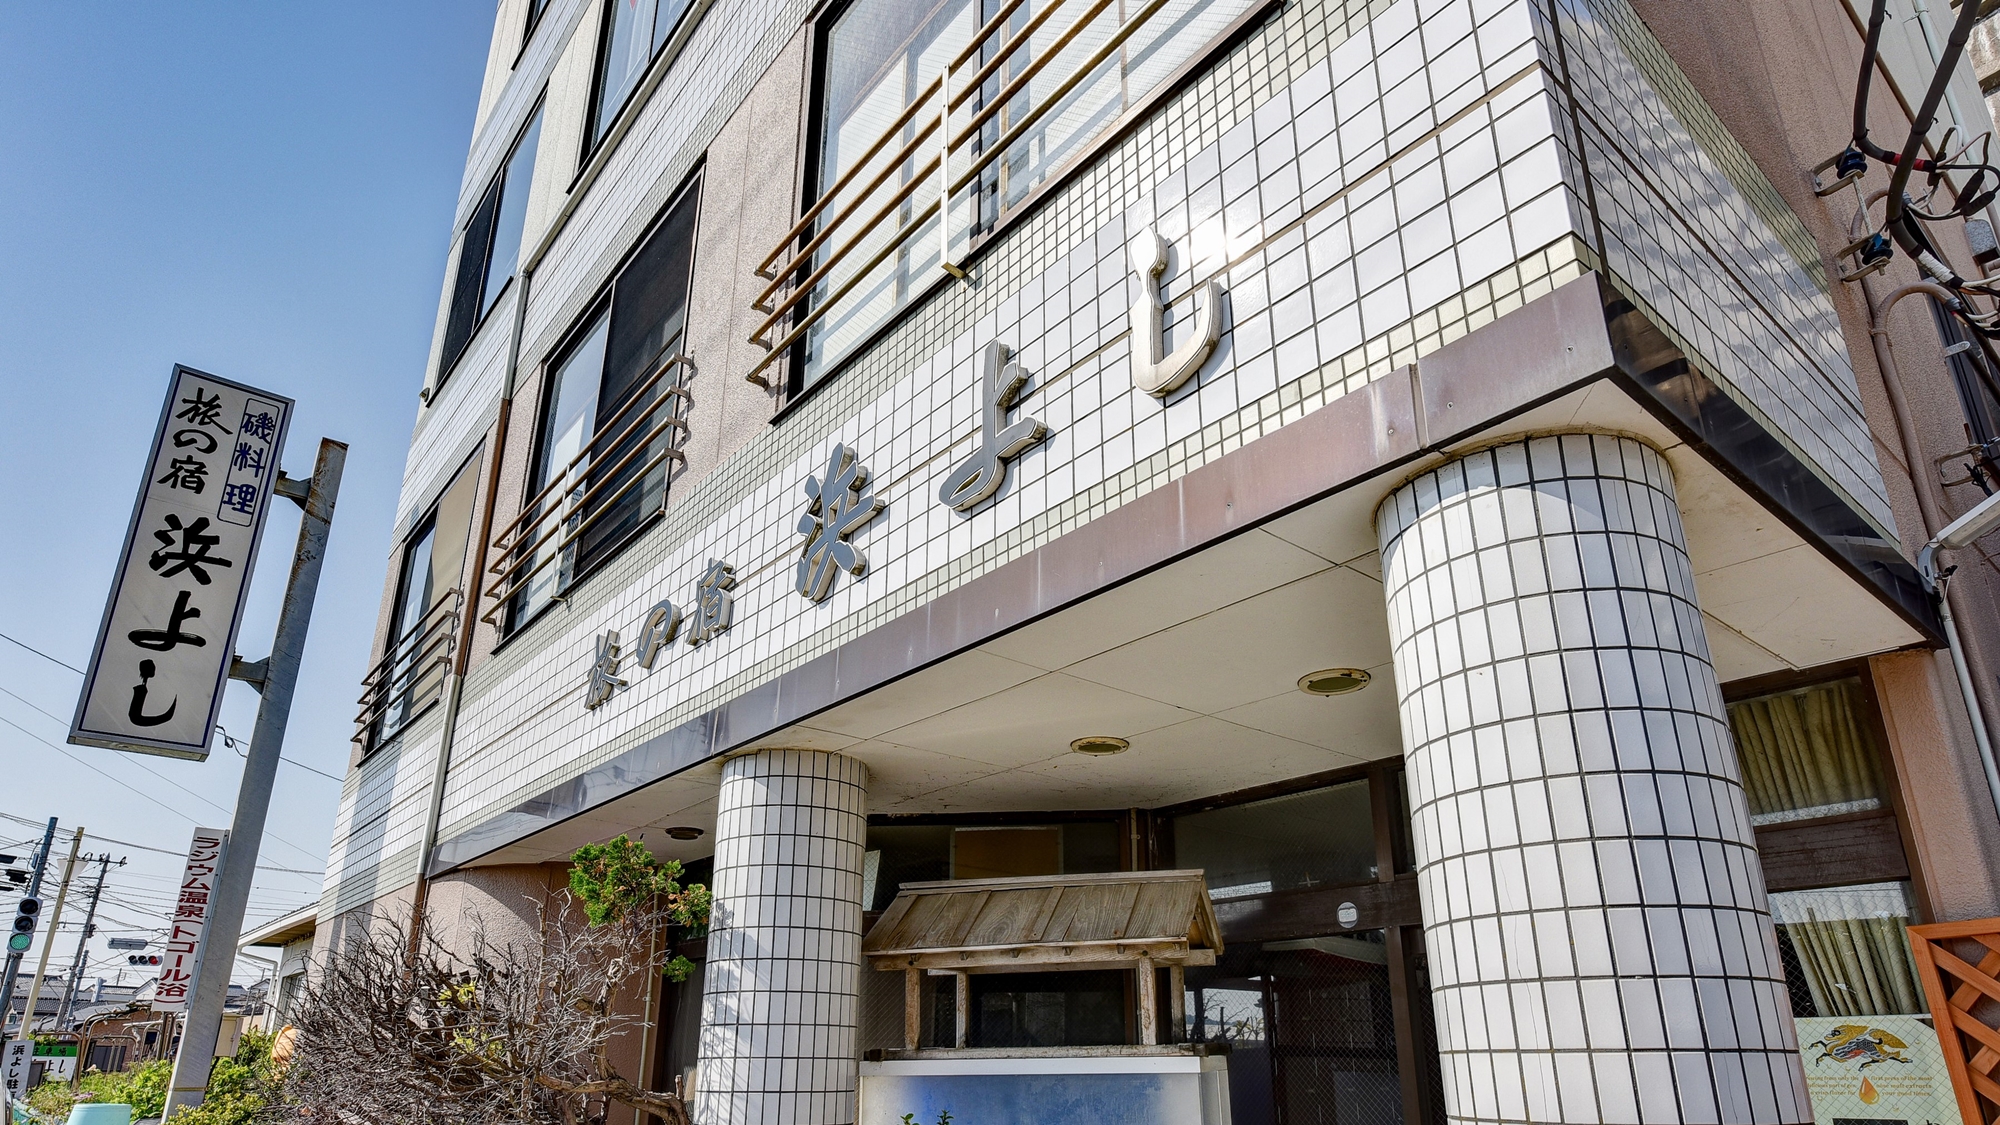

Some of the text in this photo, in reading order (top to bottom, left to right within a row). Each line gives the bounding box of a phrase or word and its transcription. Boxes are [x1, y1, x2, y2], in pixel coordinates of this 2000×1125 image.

[127, 387, 234, 727] 旅の宿 浜よし
[222, 411, 276, 515] 磯料理
[795, 224, 1224, 605] 浜よし
